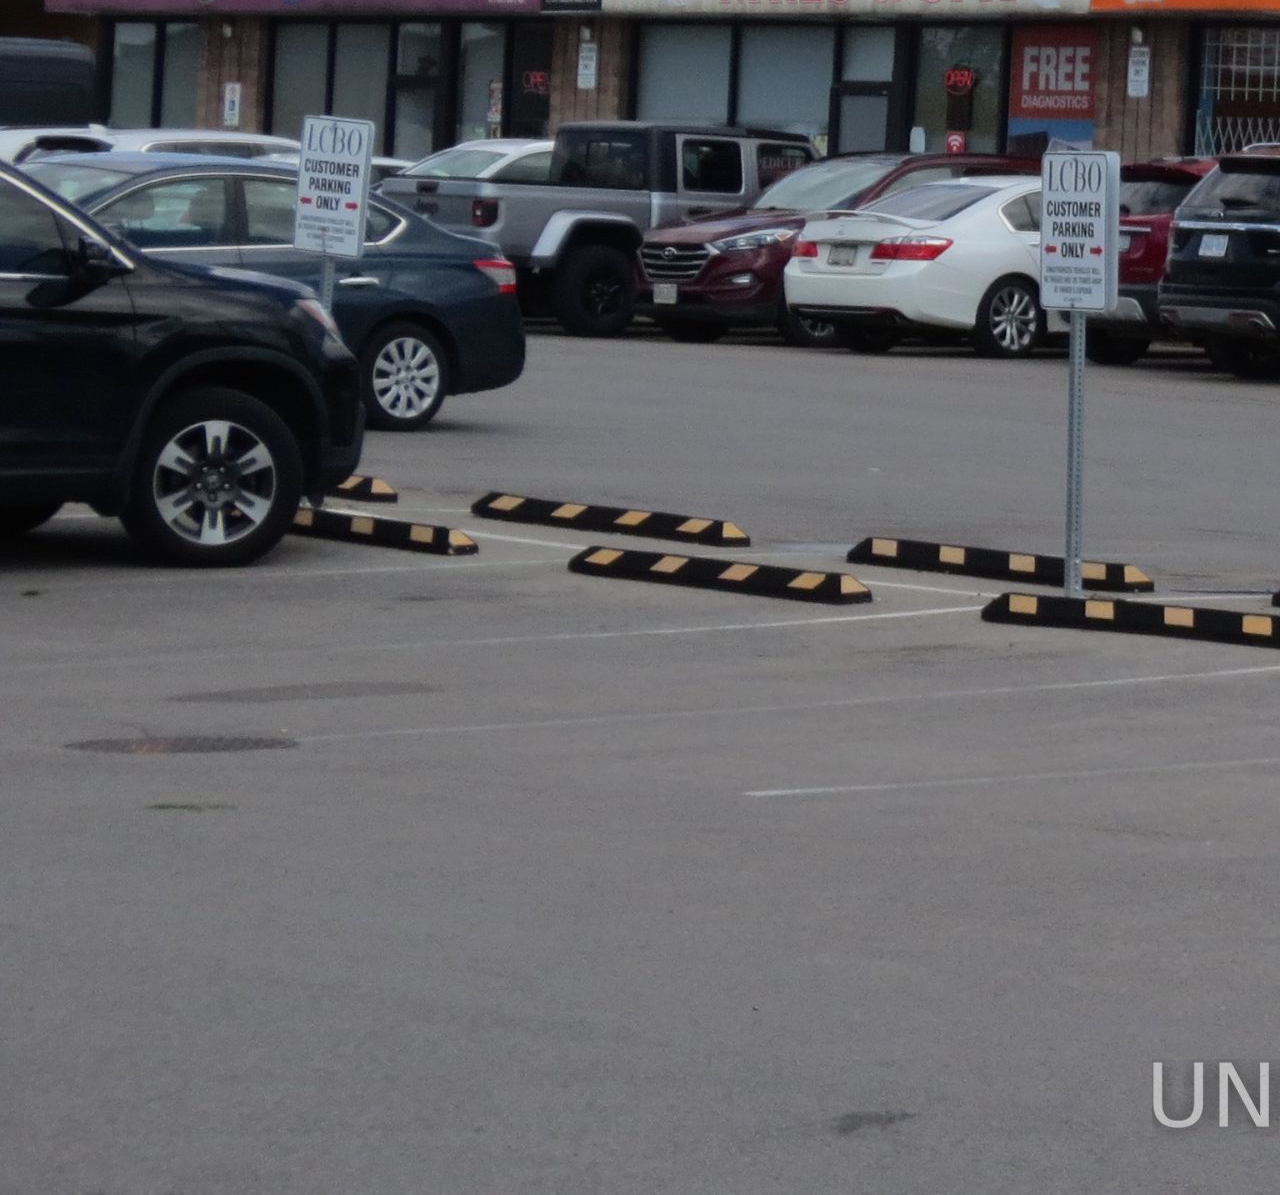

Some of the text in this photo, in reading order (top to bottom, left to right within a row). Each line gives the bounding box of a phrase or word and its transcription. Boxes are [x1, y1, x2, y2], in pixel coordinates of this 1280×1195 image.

[1022, 46, 1090, 91] FREE
[1021, 94, 1089, 109] DIAGNOSTICS
[307, 123, 362, 156] LCBO
[304, 158, 360, 177] CUSTOMER
[1048, 158, 1102, 192] LCBO
[309, 177, 351, 194] PARKING
[316, 196, 341, 211] ONLY
[1047, 200, 1101, 218] CUSTOMER
[1052, 221, 1094, 238] PARKING
[1061, 242, 1085, 258] ONLY
